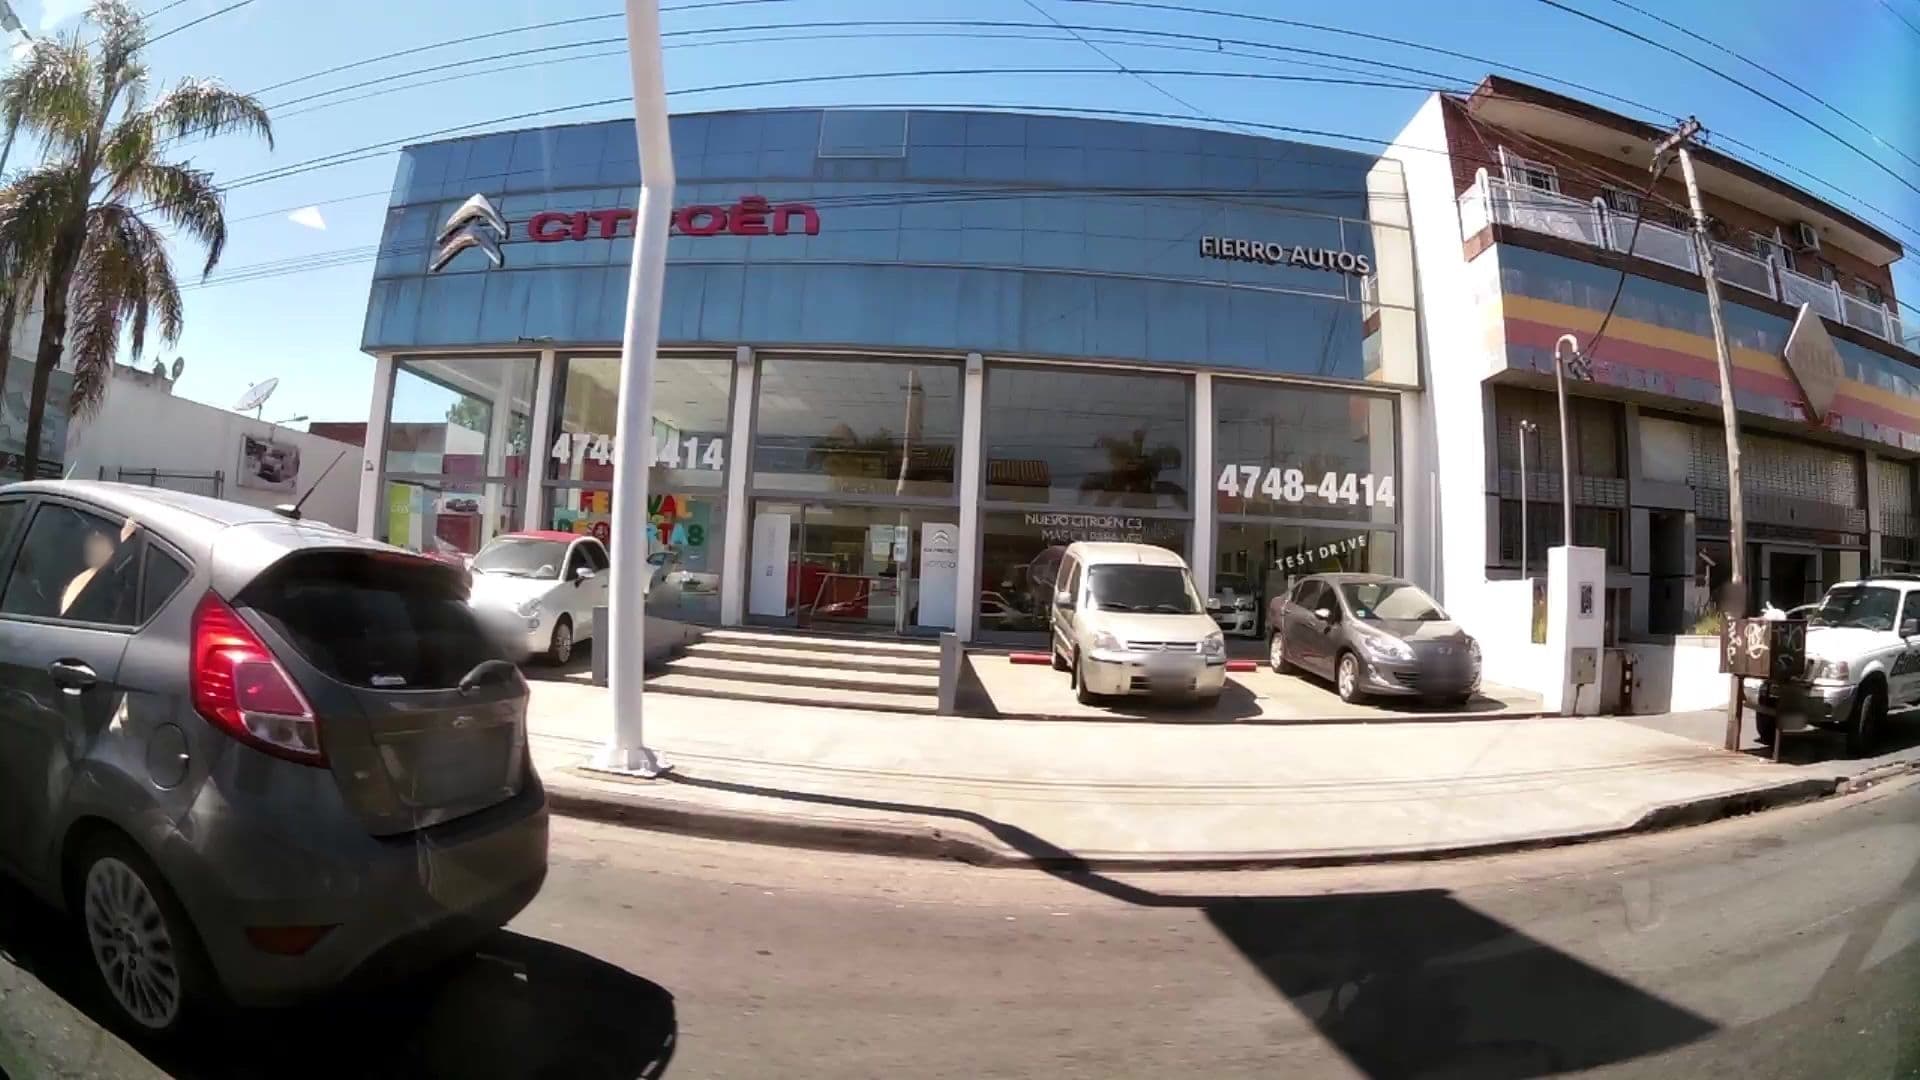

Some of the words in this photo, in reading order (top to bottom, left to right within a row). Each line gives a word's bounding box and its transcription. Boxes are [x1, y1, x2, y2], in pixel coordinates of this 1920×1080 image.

[528, 195, 820, 242] CITOËN
[1200, 235, 1283, 264] FIERRO
[1290, 245, 1370, 275] AUTOS
[1217, 464, 1395, 507] 4748-4414
[580, 491, 693, 520] FEVAL
[1127, 518, 1143, 529] C3
[1275, 550, 1314, 571] TEST
[1319, 535, 1367, 559] DRIVE
